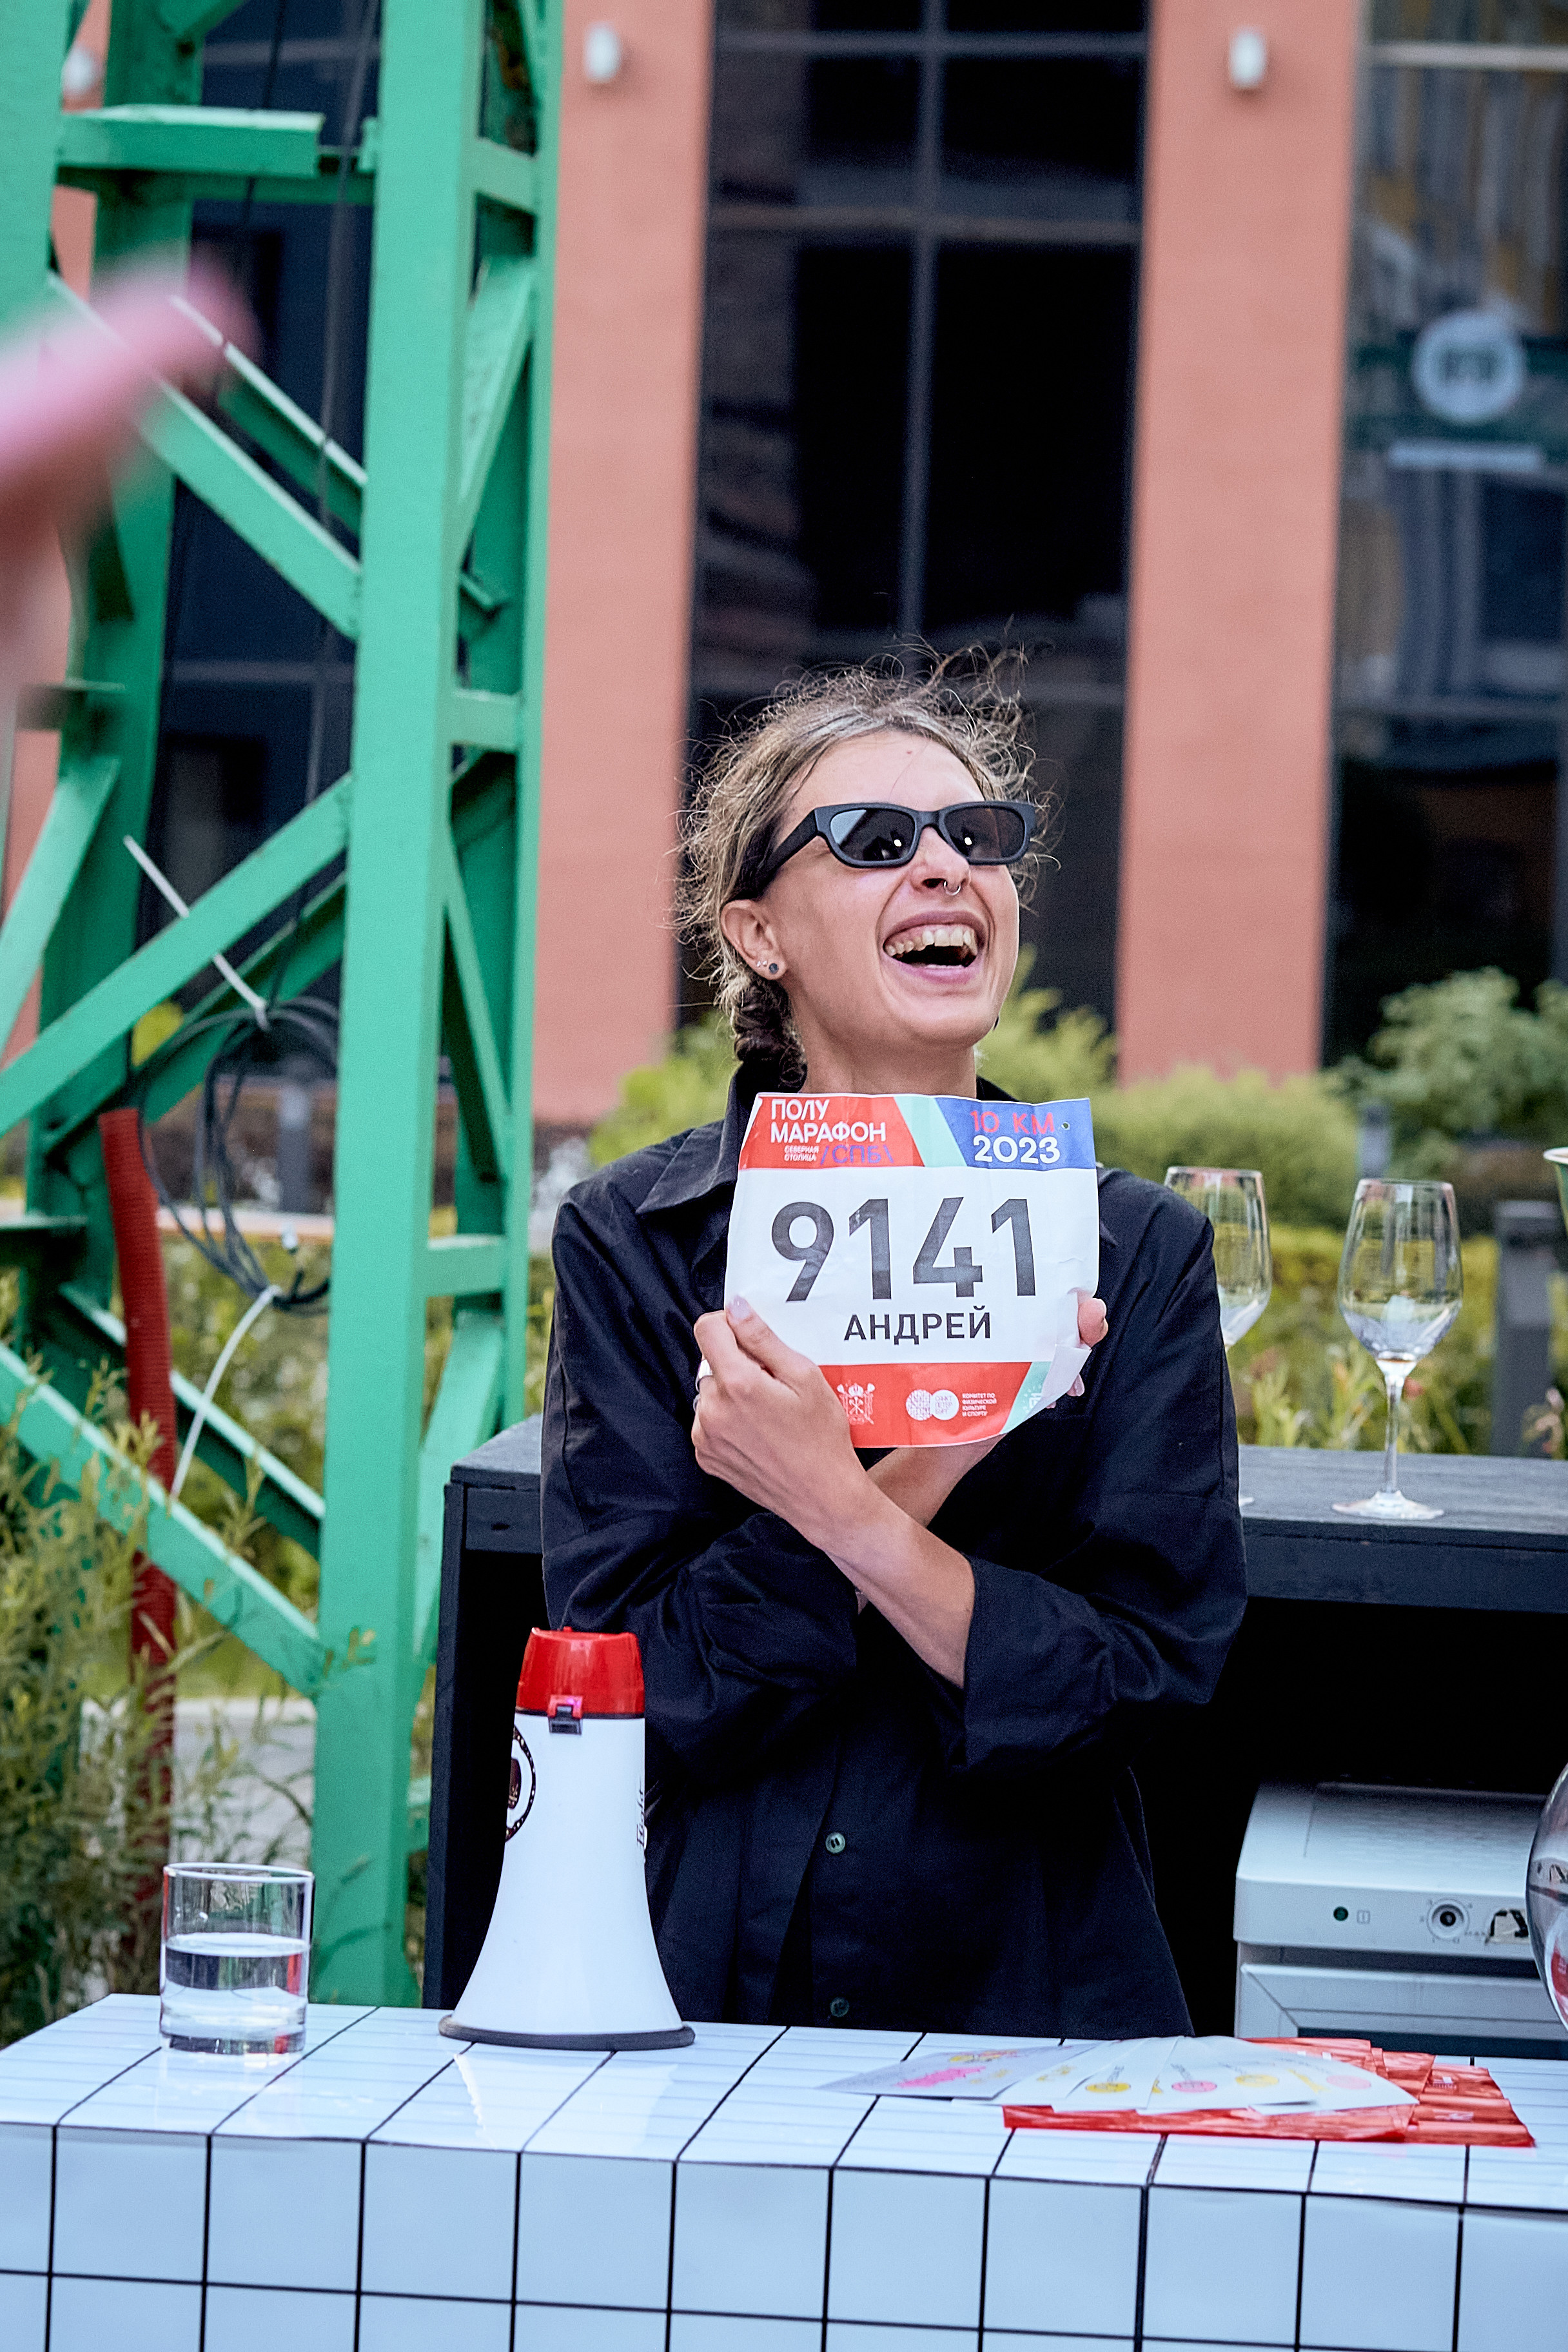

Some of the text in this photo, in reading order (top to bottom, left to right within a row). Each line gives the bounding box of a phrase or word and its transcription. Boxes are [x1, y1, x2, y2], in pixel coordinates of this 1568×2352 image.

[771, 1099, 830, 1120] ПОЛУ
[770, 1121, 887, 1143] МАРАФОН
[970, 1110, 1055, 1135] 10 КМ
[784, 1144, 819, 1153] СЕВЕРНАЯ
[784, 1153, 817, 1162] СТОЛИЦА
[973, 1135, 1061, 1164] 2023
[771, 1197, 1036, 1302] 9141
[843, 1306, 991, 1345] АНДРЕЙ
